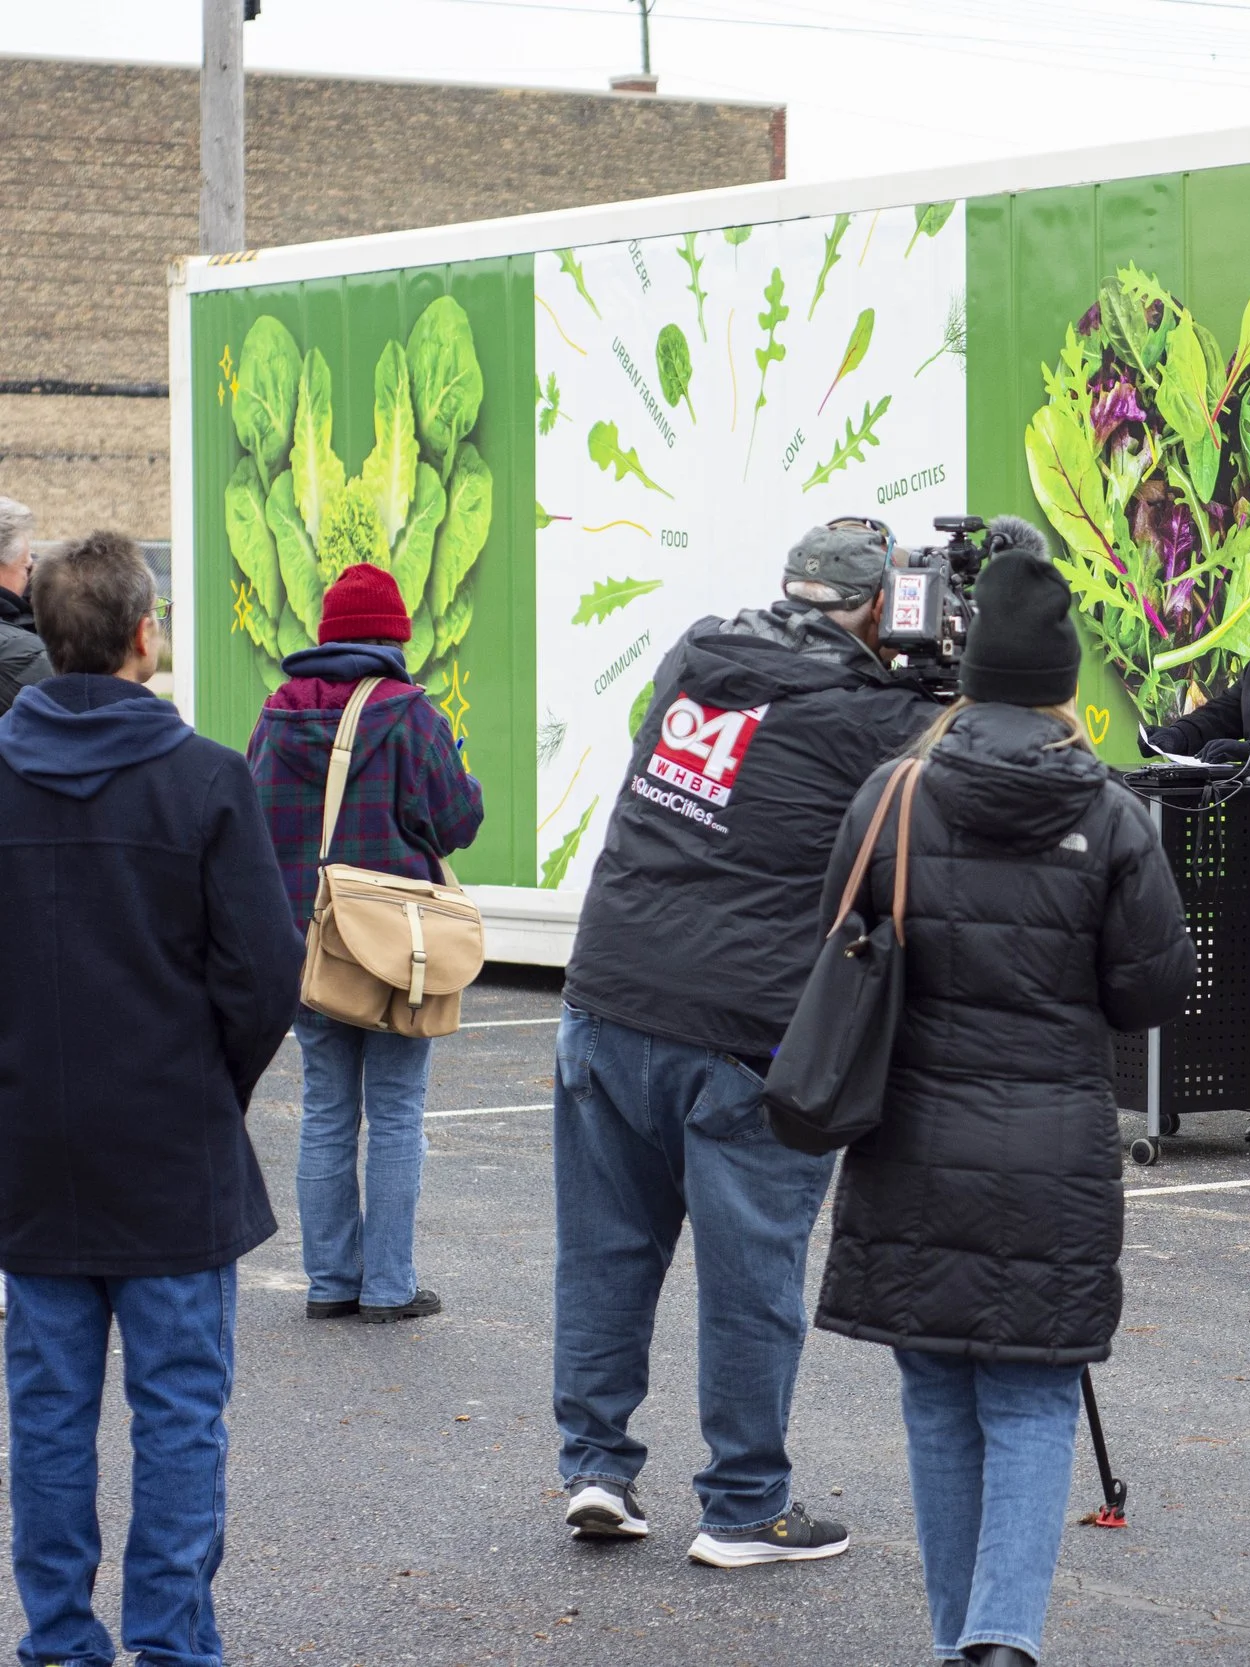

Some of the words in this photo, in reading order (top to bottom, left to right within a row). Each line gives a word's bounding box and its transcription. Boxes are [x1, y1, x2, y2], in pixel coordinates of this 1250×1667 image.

[611, 336, 642, 388] URBAN
[639, 382, 676, 449] FARMING
[782, 428, 806, 472] LOVE
[877, 478, 908, 505] QUAD
[910, 464, 946, 492] CITIES
[661, 529, 688, 548] FOOD
[594, 628, 651, 696] COMMUNITY
[655, 760, 721, 799] WHBF
